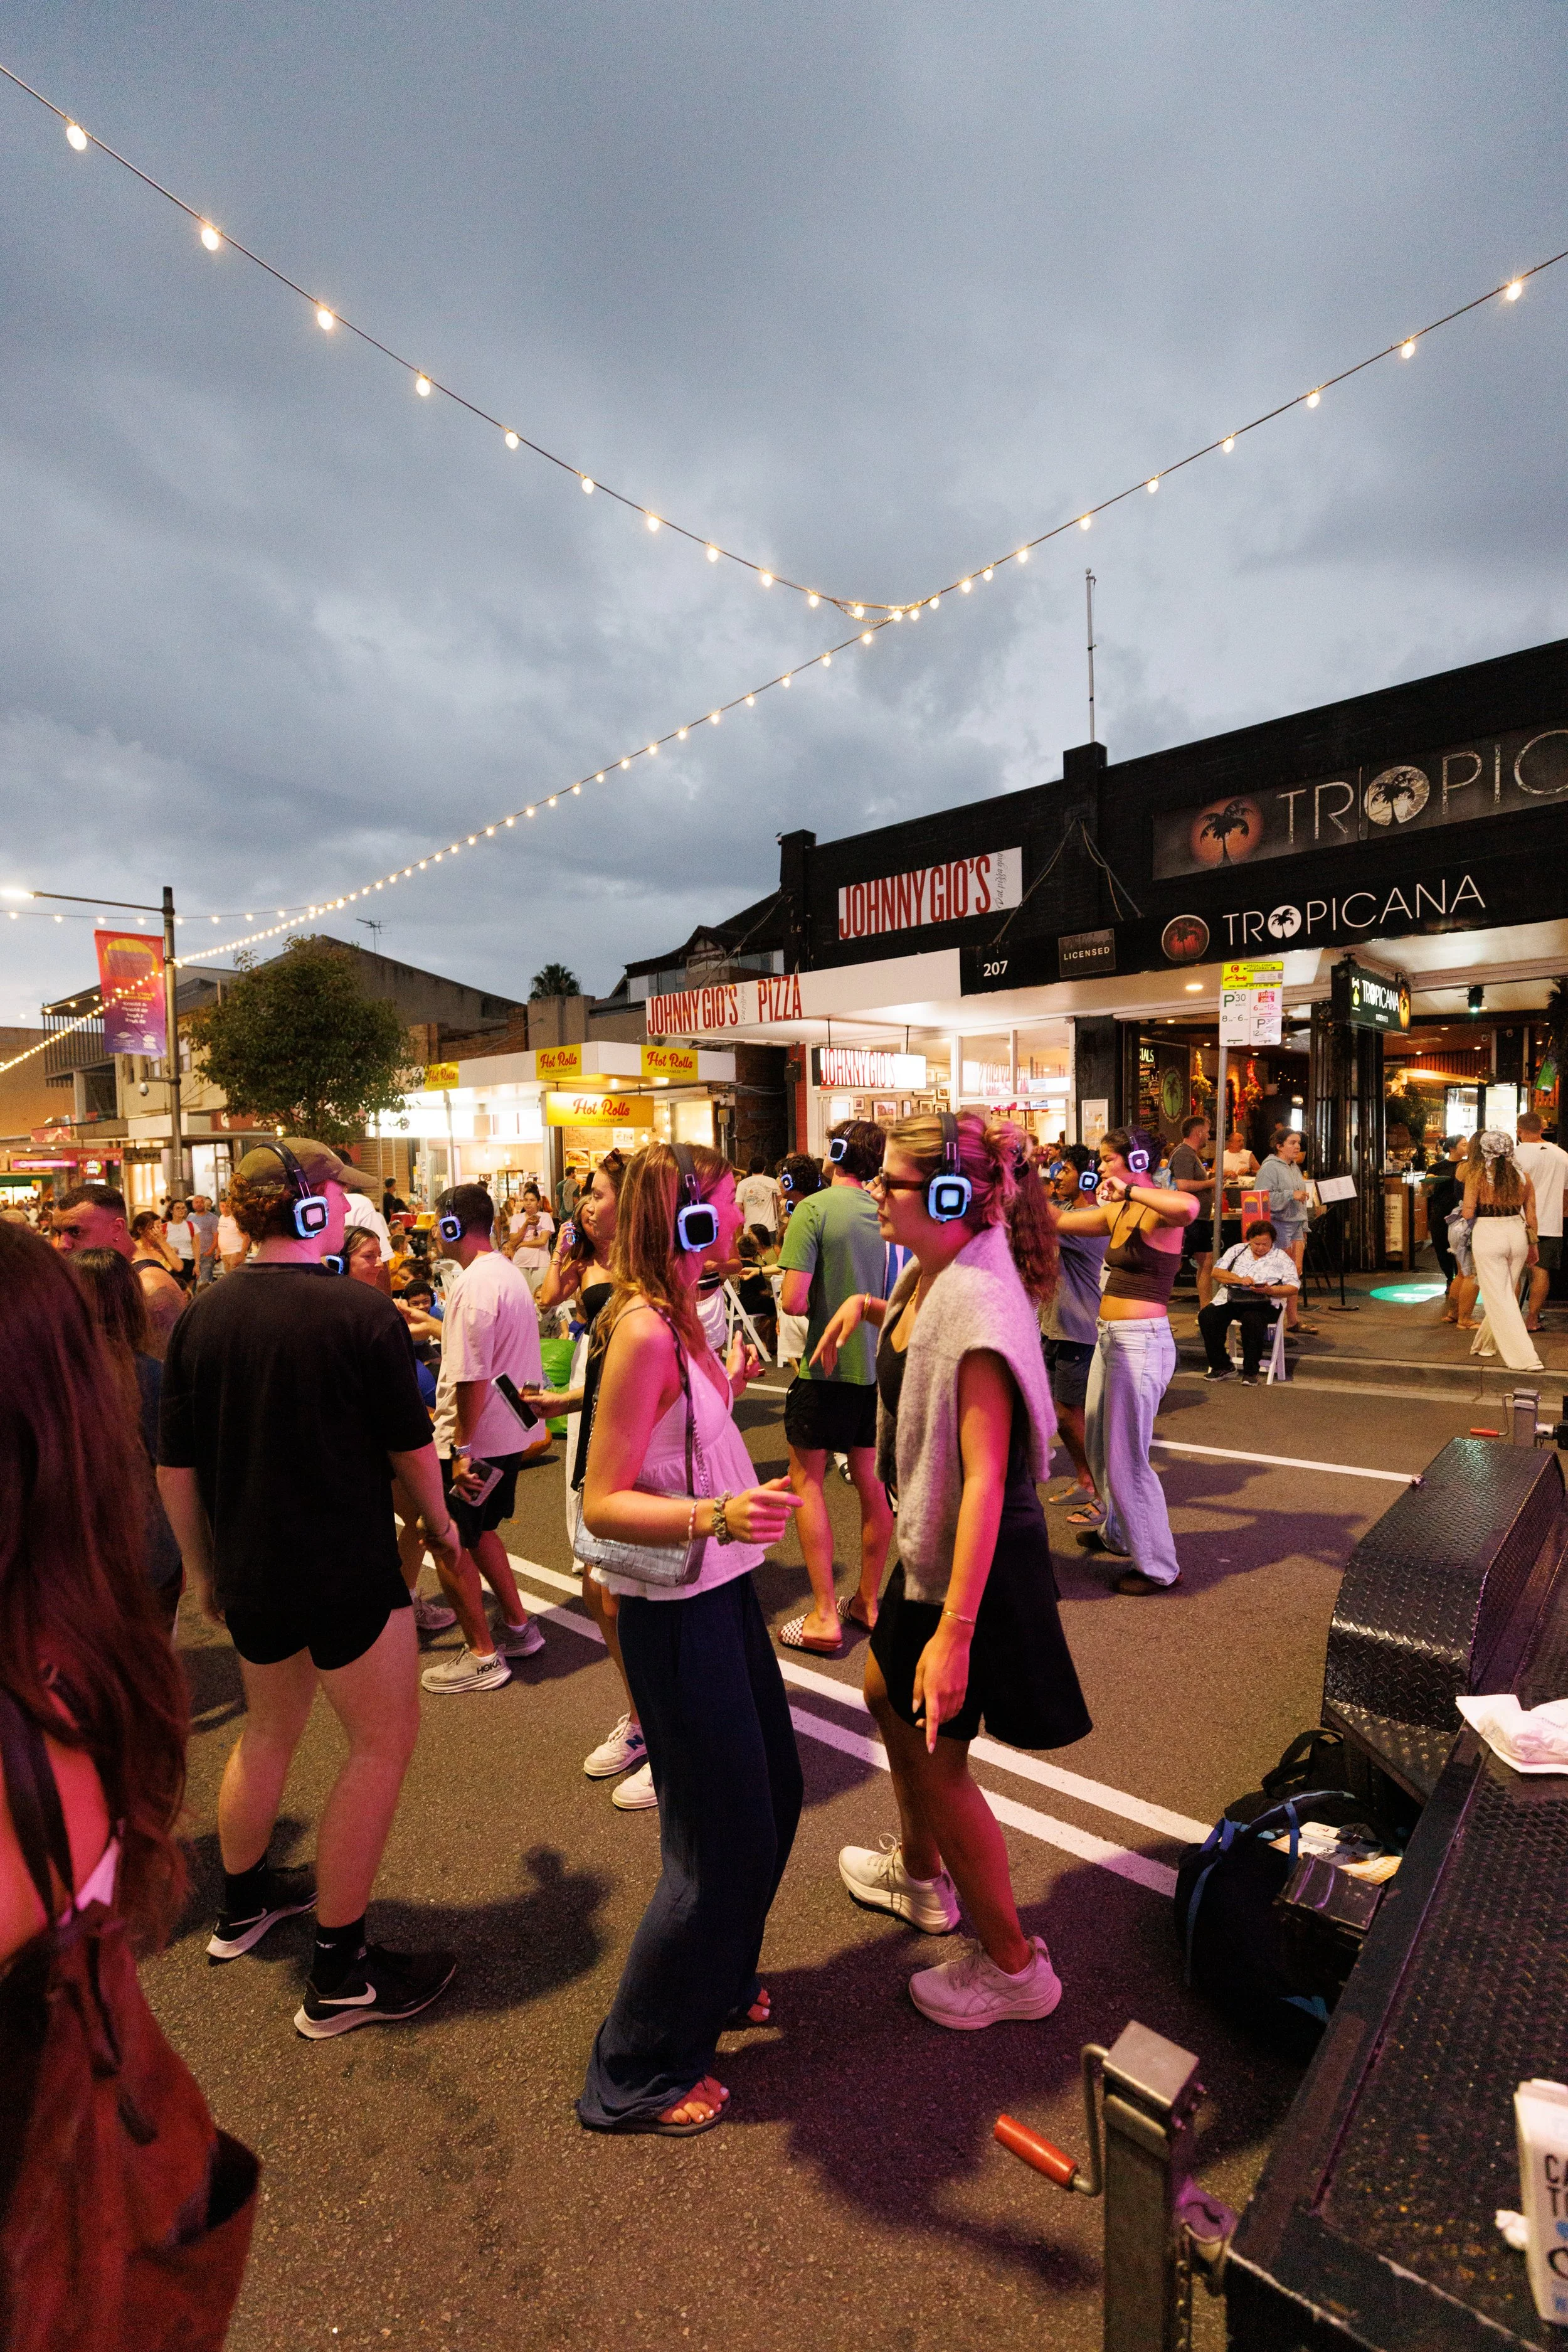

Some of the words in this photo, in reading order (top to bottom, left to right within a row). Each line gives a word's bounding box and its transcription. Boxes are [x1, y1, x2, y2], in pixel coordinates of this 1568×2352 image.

[839, 869, 926, 940] JOHNNY
[930, 854, 991, 923] GIO'S
[1222, 875, 1486, 945] TROPICANA
[1064, 946, 1110, 960] LICENSED
[983, 960, 1009, 977] 207
[1224, 994, 1234, 1008] P
[1236, 994, 1246, 1002] 30
[1362, 979, 1399, 1012] TROPICANA
[648, 989, 700, 1036] JOHNNY
[702, 984, 738, 1029] GIO'S
[758, 974, 803, 1023] PIZZA
[1257, 1019, 1266, 1029] P
[540, 1054, 556, 1068] Hot
[558, 1051, 577, 1066] Rolls
[647, 1051, 667, 1065] Hot
[669, 1053, 692, 1068] Rolls
[820, 1048, 867, 1087] JOHNNY
[573, 1098, 597, 1115] Hot
[601, 1099, 630, 1116] Rolls
